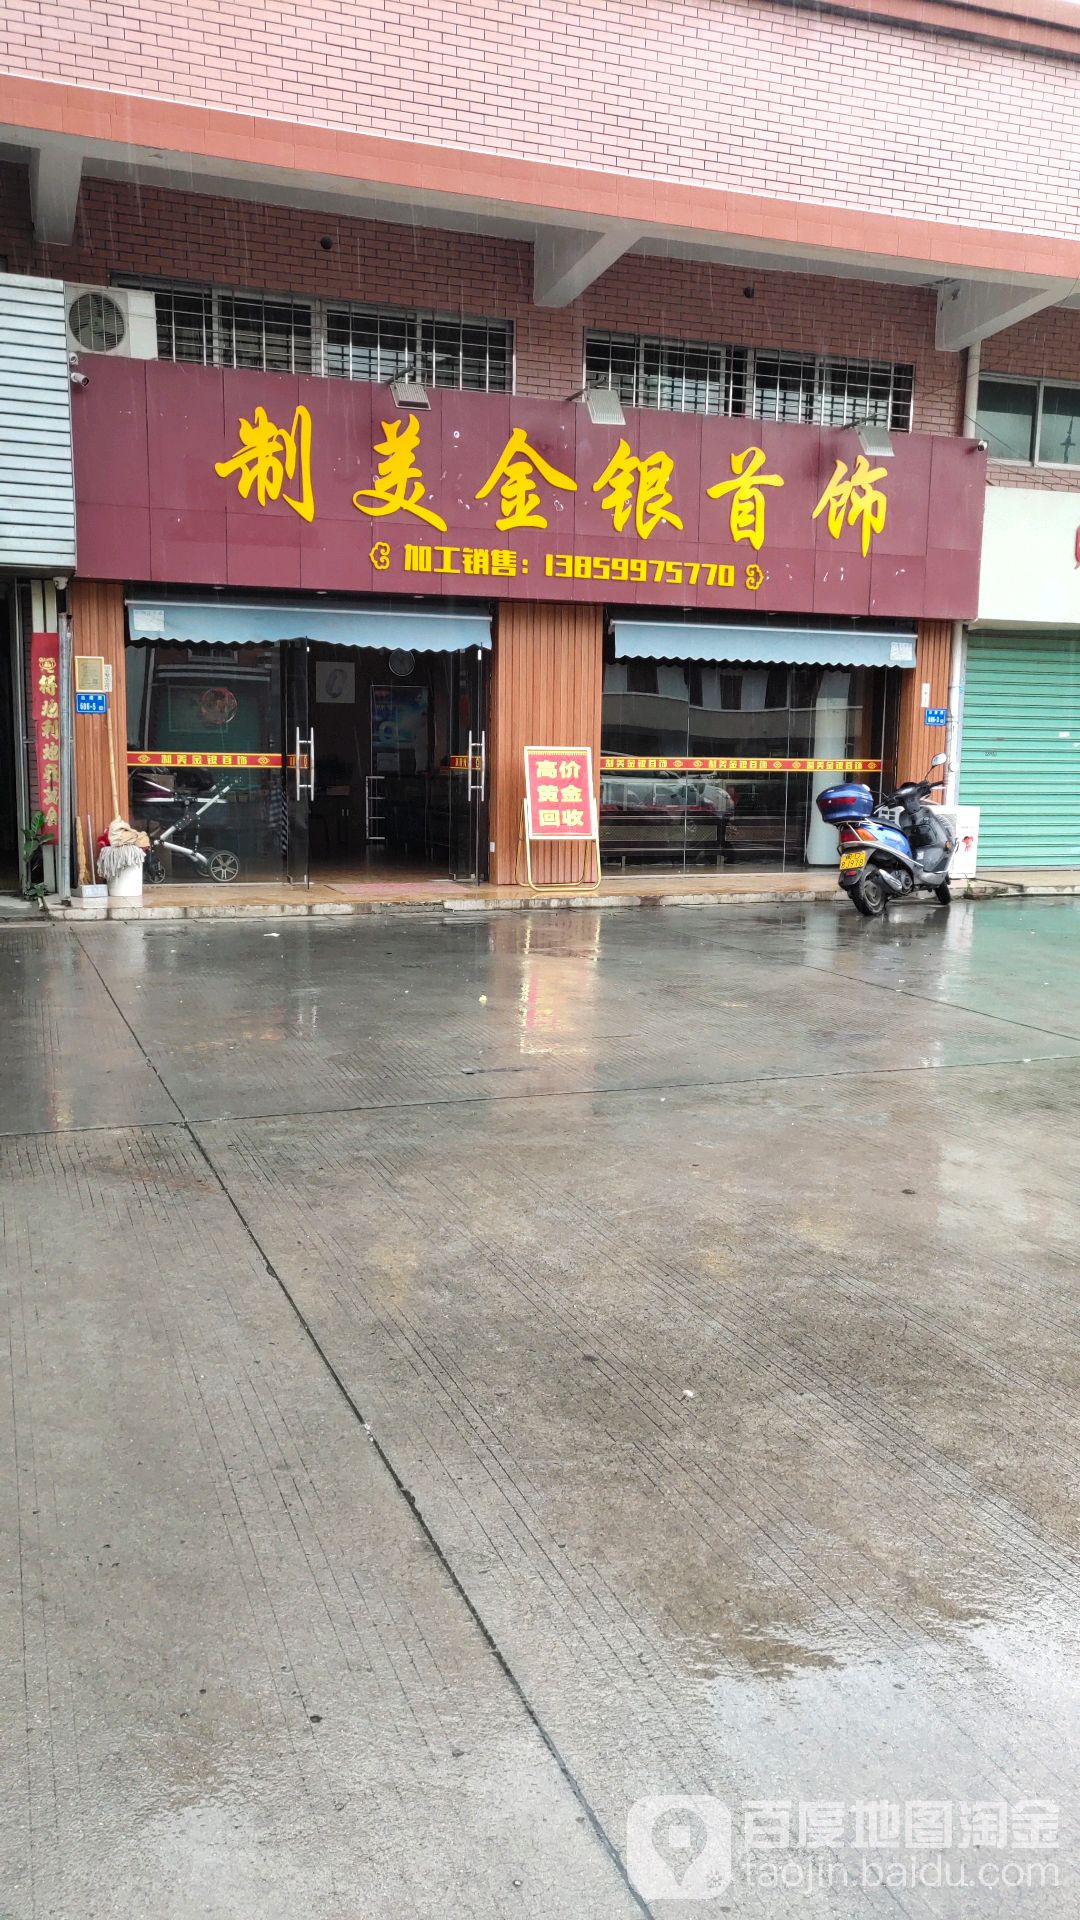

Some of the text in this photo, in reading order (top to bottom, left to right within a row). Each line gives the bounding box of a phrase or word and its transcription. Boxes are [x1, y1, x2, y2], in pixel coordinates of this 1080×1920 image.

[214, 405, 888, 558] 制美金银首饰
[161, 754, 248, 765] 制美金银首饰
[535, 760, 581, 779] 高价
[537, 784, 583, 802] 黄金
[538, 808, 584, 827] 回收
